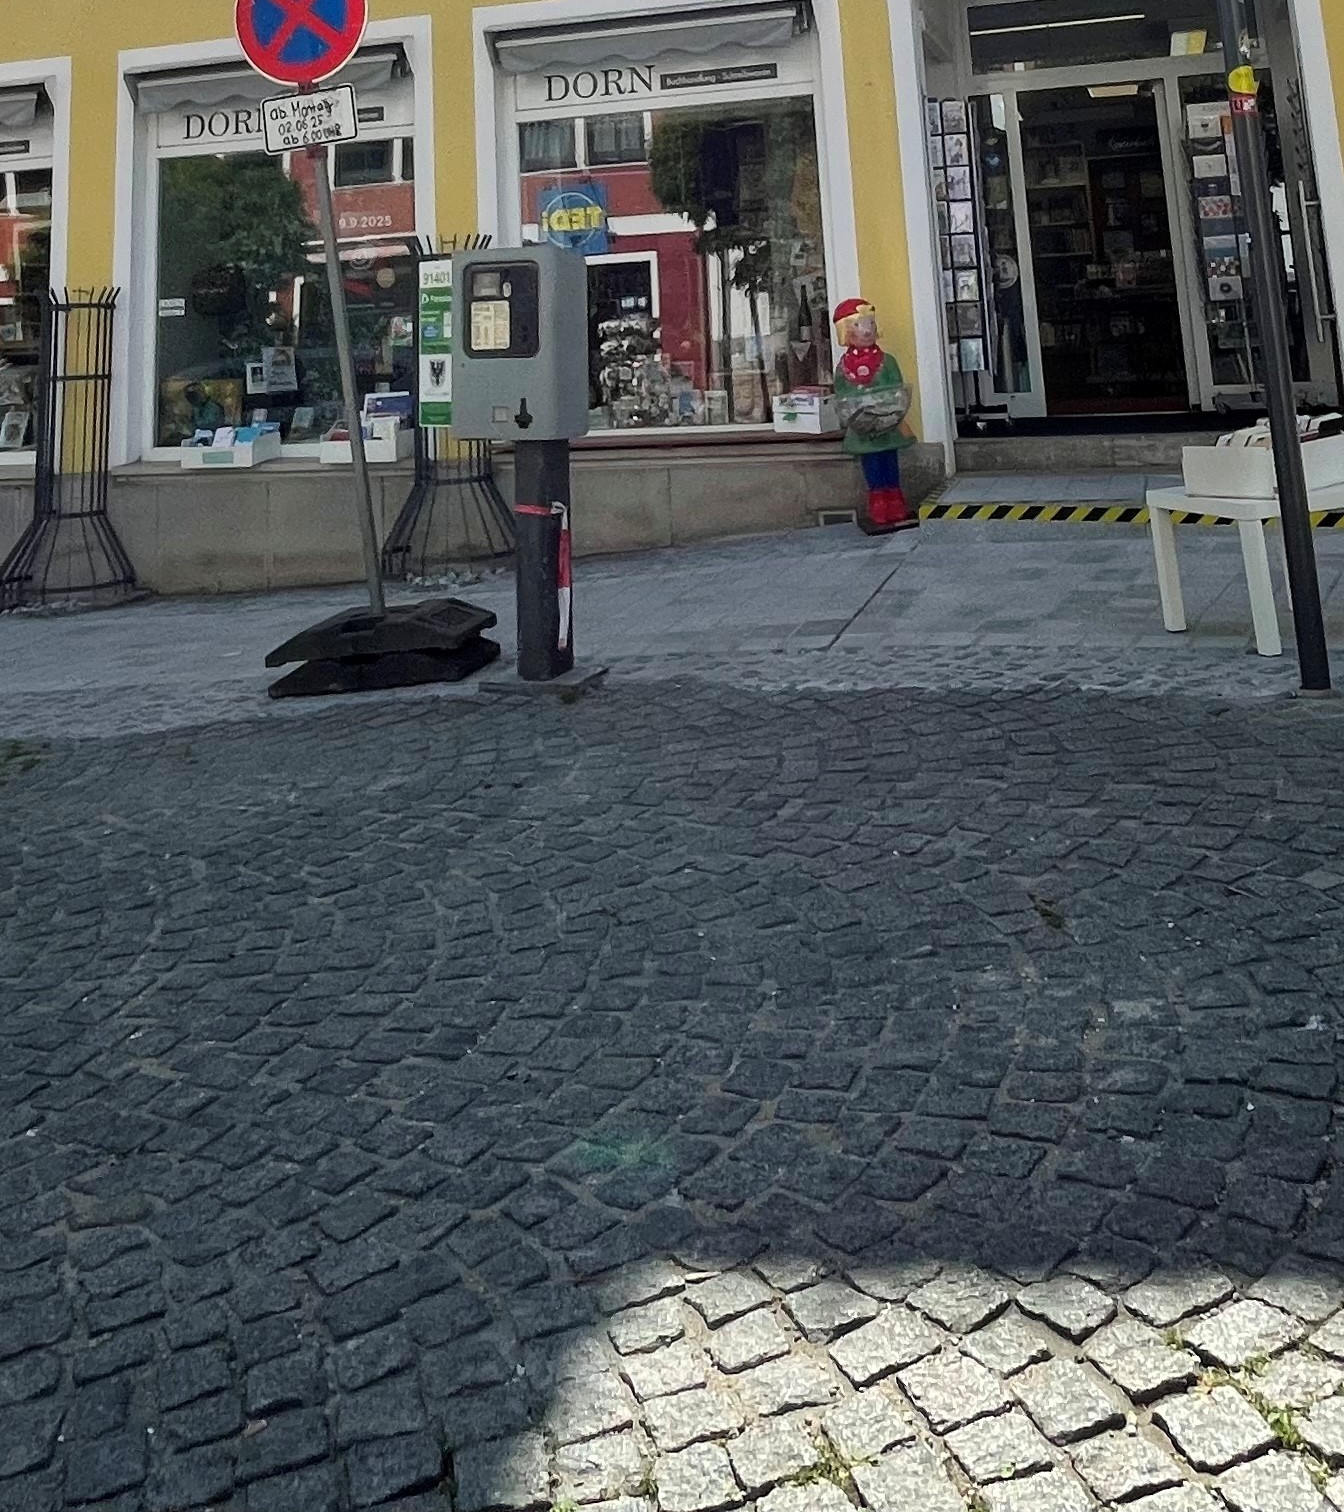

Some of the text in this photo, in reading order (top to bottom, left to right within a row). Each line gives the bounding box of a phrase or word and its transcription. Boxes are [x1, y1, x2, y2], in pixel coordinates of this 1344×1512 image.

[544, 65, 655, 101] DORN
[282, 135, 299, 146] ab
[423, 271, 451, 286] 91401
